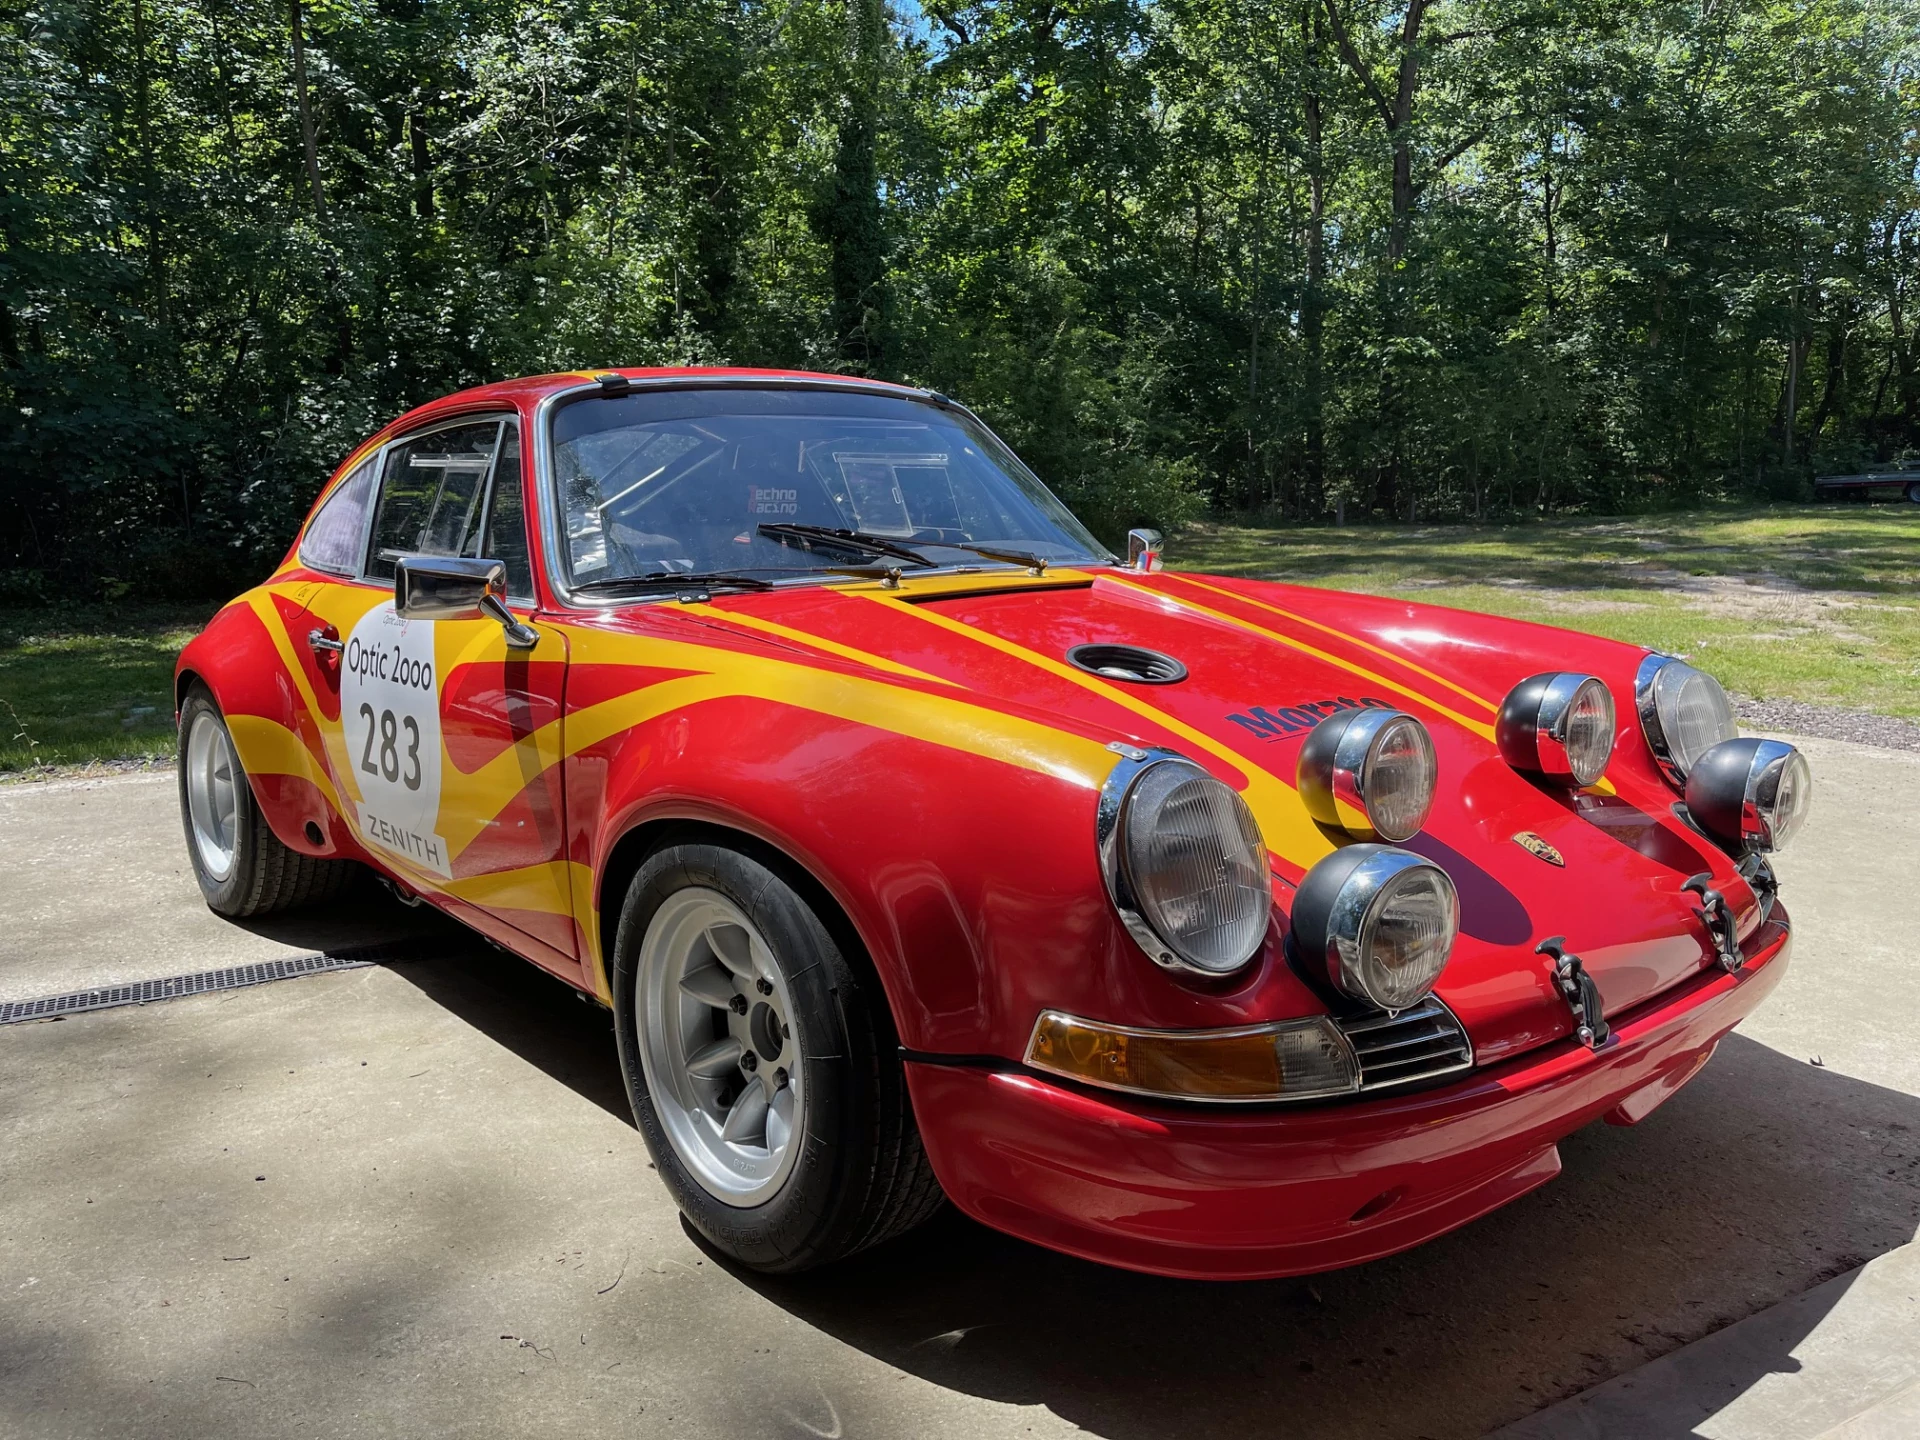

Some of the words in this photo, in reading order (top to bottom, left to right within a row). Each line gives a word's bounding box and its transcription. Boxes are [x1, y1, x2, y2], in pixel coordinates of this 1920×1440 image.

[747, 484, 797, 500] Techno
[747, 499, 798, 516] Racing
[348, 636, 388, 687] Optic
[391, 645, 432, 691] 2000
[360, 701, 422, 792] 283
[368, 813, 440, 867] ZENITH
